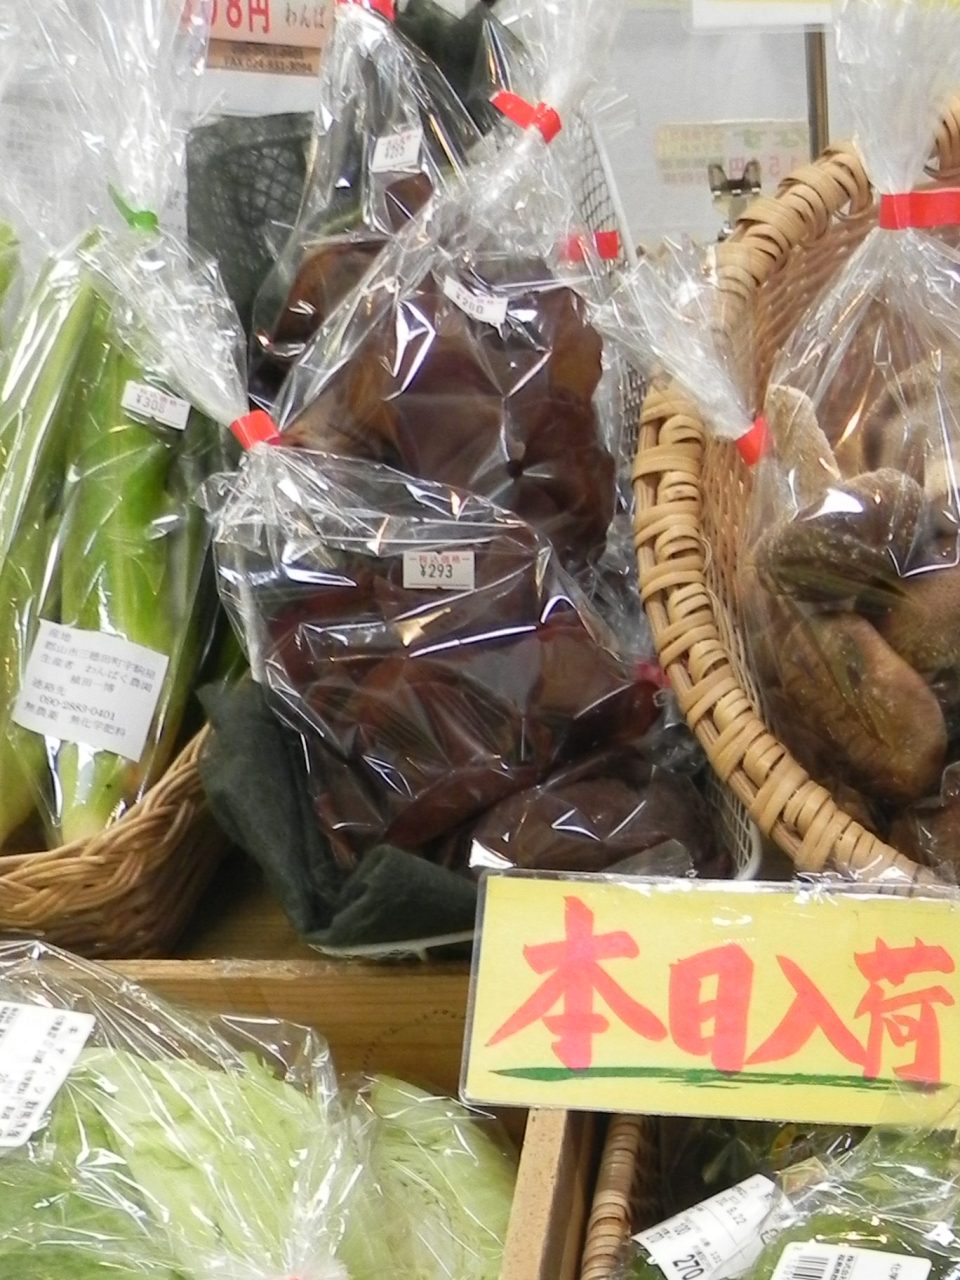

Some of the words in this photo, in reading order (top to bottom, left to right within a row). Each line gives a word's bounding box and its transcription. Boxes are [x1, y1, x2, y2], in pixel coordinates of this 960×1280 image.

[420, 563, 453, 579] ¥293
[484, 896, 955, 1092] 本日入荷
[672, 1254, 705, 1280] 270
